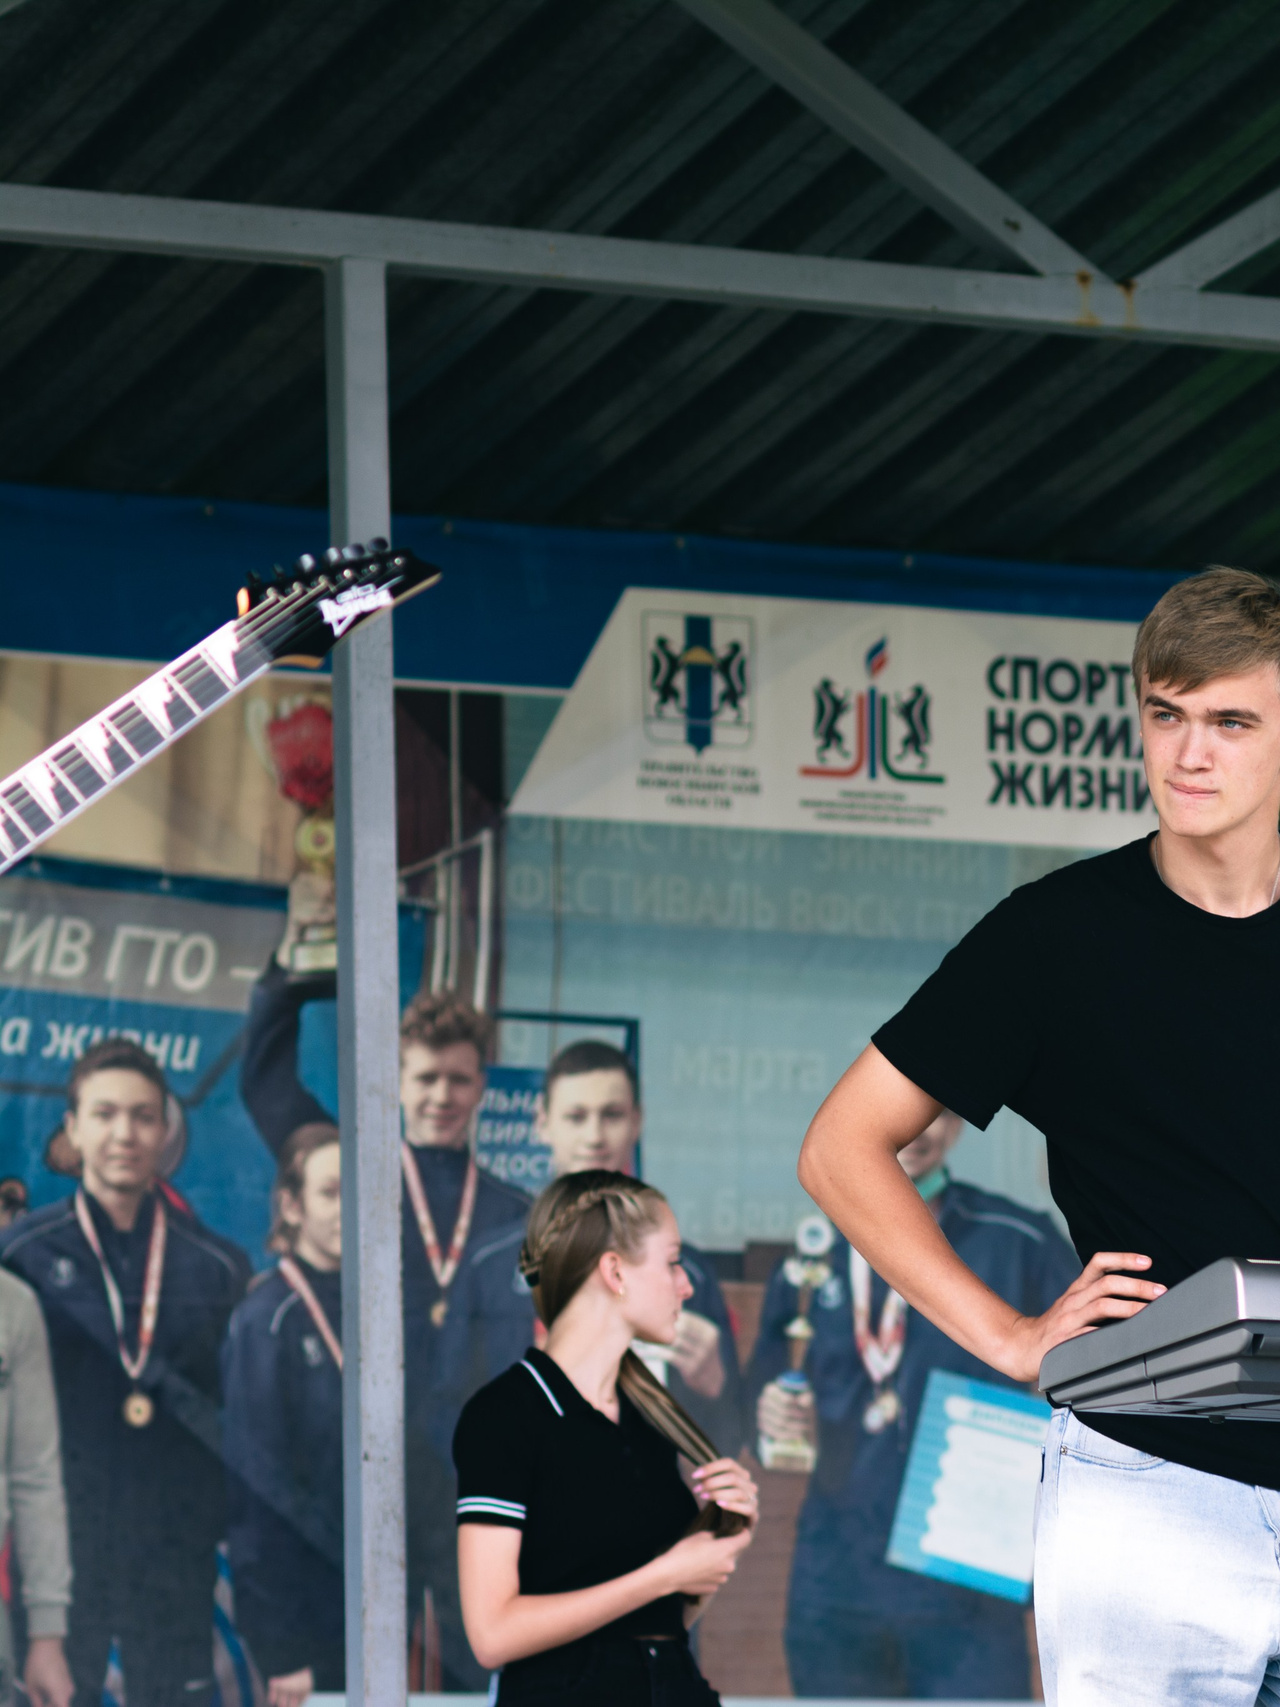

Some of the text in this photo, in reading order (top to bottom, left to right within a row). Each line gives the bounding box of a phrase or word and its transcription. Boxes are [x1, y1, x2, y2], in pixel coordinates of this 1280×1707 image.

[987, 656, 1131, 706] СПОРТ
[987, 708, 1143, 760] НОРМ
[0, 909, 94, 979] ИВ
[104, 922, 219, 992] ГТО
